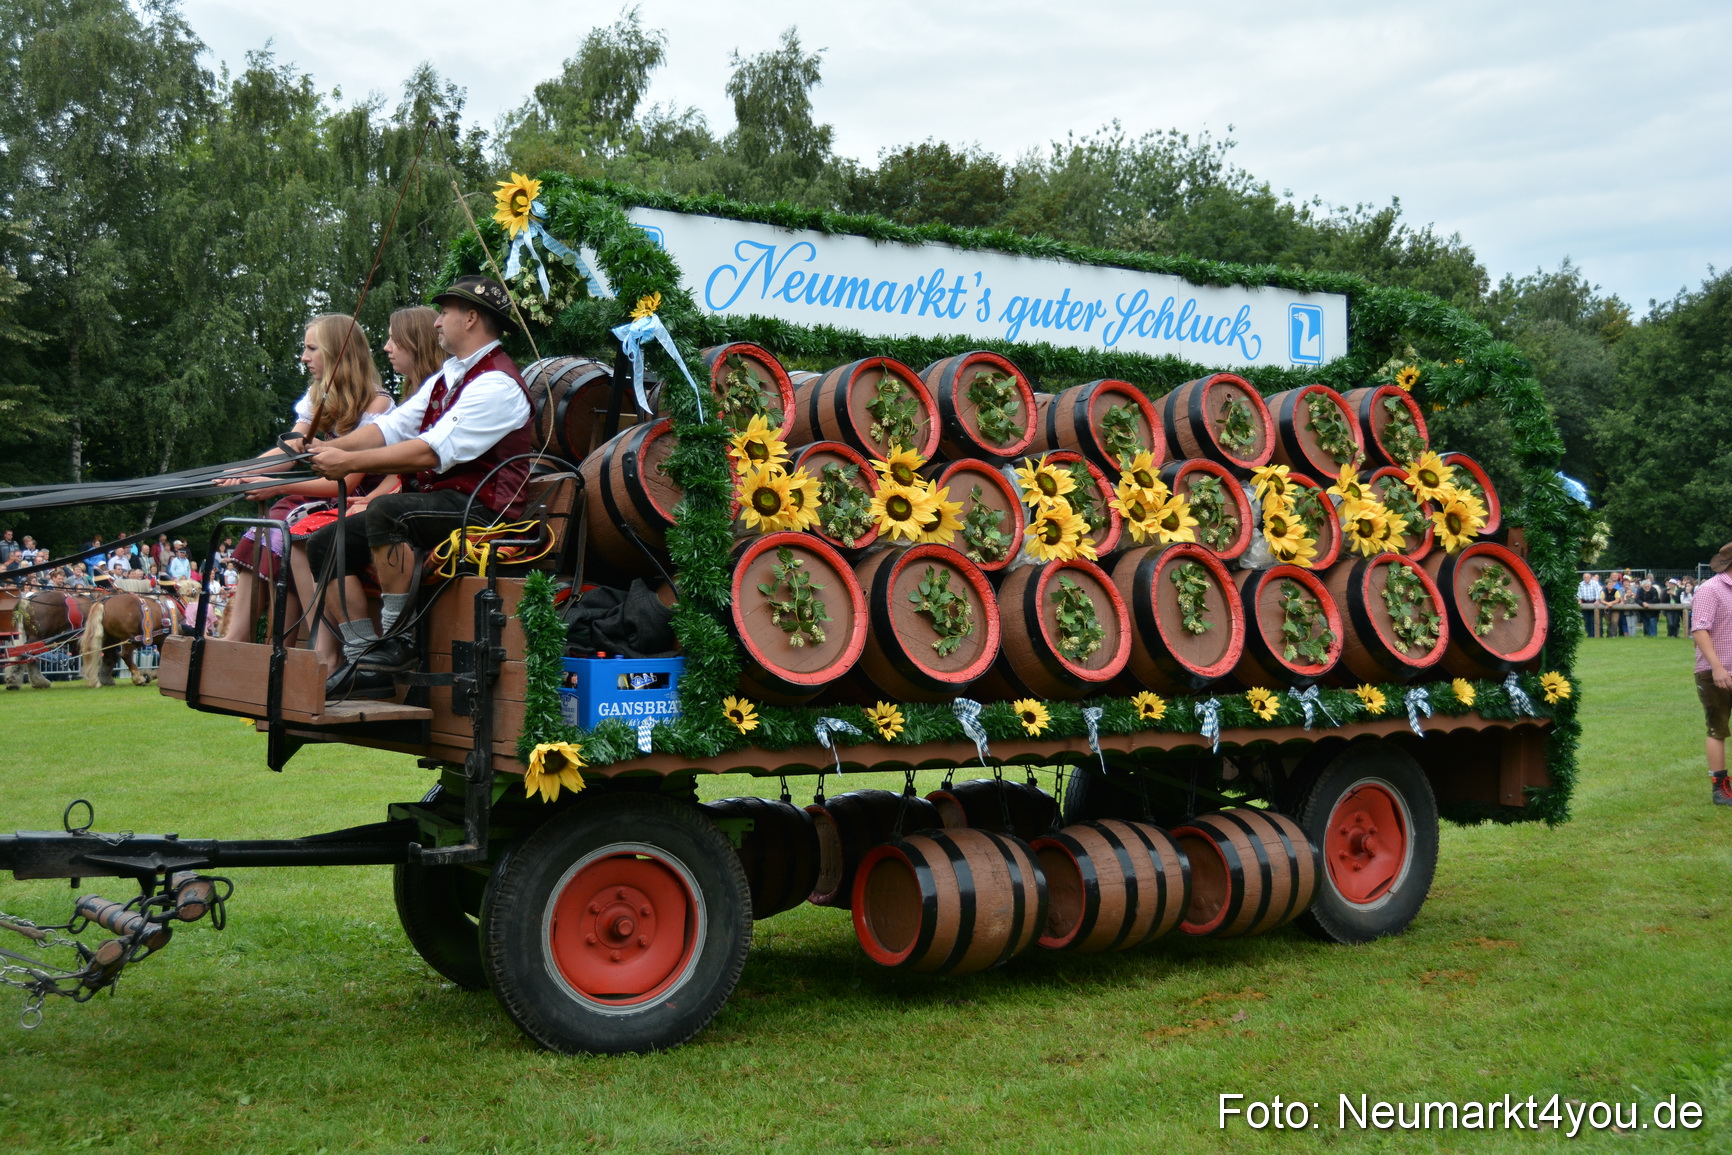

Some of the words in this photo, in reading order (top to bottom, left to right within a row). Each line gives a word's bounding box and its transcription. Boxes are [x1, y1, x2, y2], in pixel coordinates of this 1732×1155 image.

[704, 239, 993, 323] Neumarkt's
[998, 287, 1107, 343] guter
[1102, 288, 1262, 361] Schluck
[598, 700, 683, 717] GANSBRÄ
